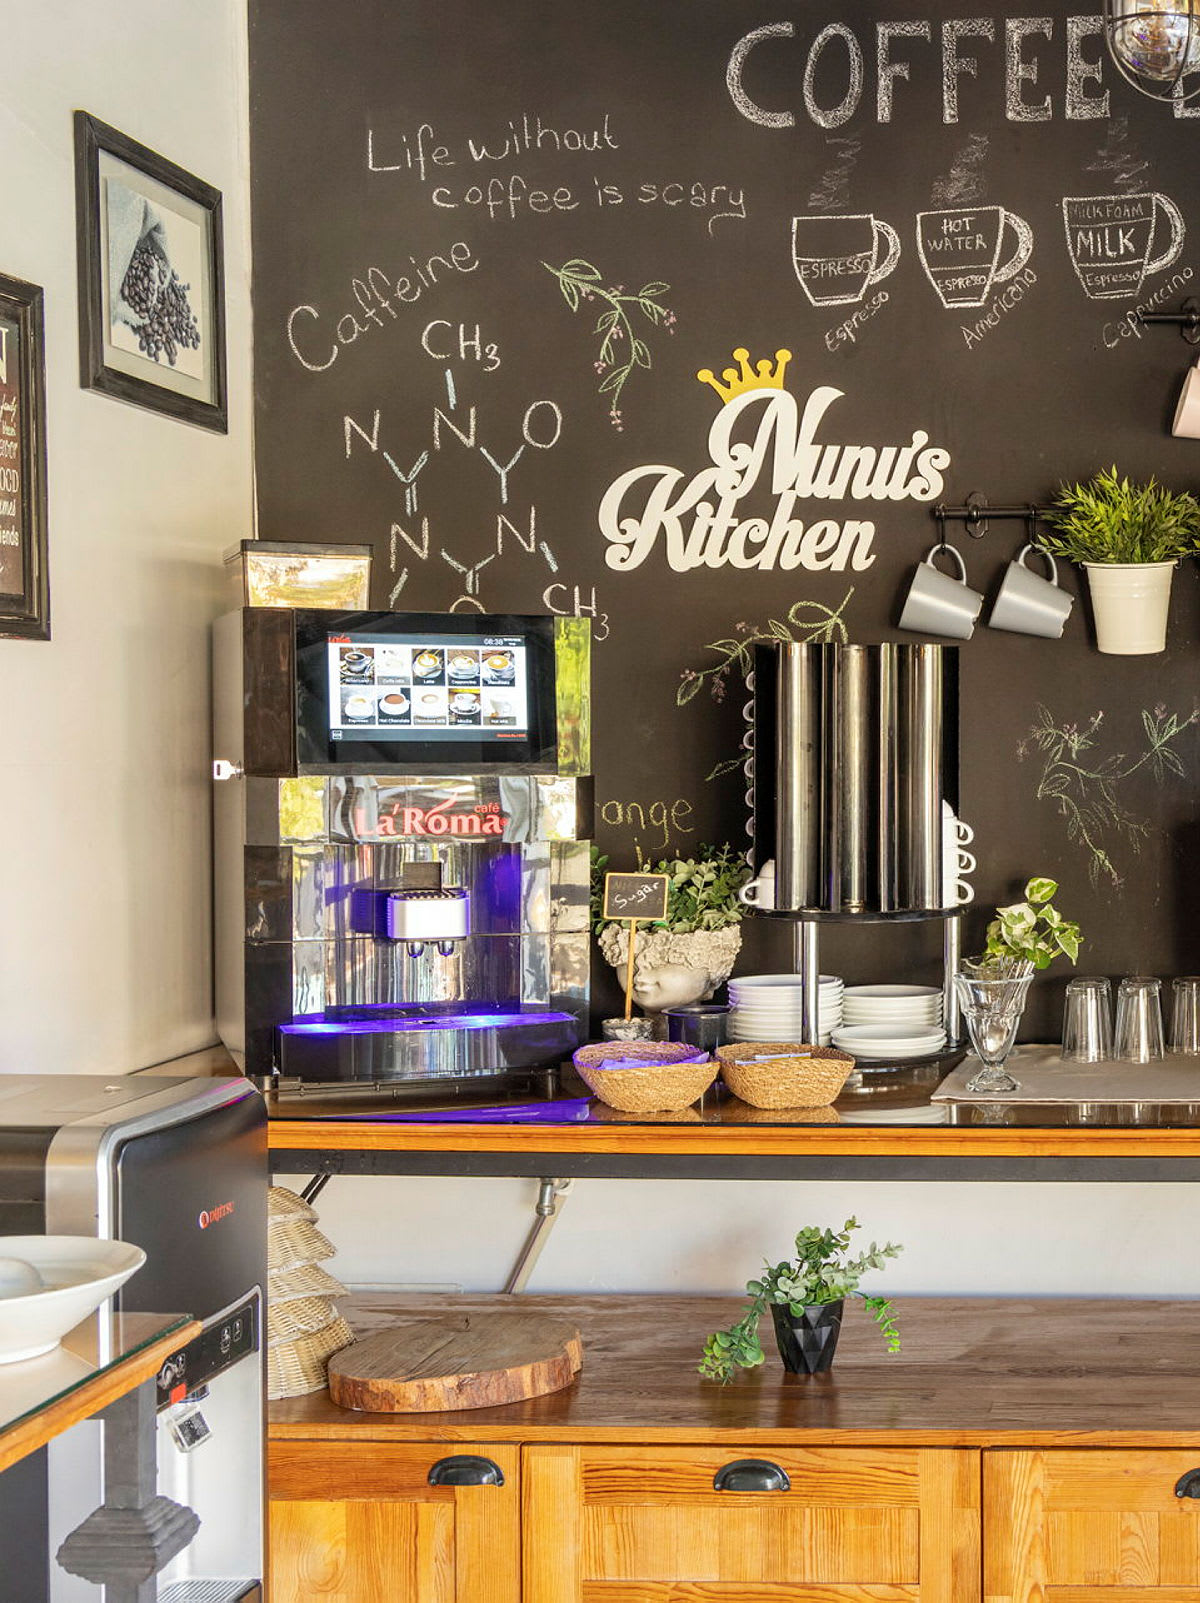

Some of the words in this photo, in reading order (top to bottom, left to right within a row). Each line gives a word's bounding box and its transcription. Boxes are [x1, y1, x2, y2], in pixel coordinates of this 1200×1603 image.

[726, 16, 1111, 128] COFFEE
[368, 125, 456, 180] Life
[469, 114, 620, 161] without
[432, 175, 580, 219] coffee
[594, 177, 624, 206] is
[638, 182, 746, 237] scary
[941, 217, 976, 233] HOT
[1106, 203, 1144, 218] FOAM
[800, 257, 872, 279] ESPRESSO
[928, 234, 987, 251] WATER
[1077, 227, 1135, 258] MILK
[287, 242, 479, 371] Caffeine
[937, 275, 988, 292] ESPRESSO
[959, 268, 1038, 350] Americano
[421, 320, 500, 371] CH3
[824, 291, 890, 352] Espresso
[344, 409, 380, 459] N
[433, 406, 477, 450] N
[708, 386, 951, 501] Nunu's
[598, 464, 876, 573] Kitchen
[596, 799, 695, 850] ange
[614, 881, 660, 910] Sugar
